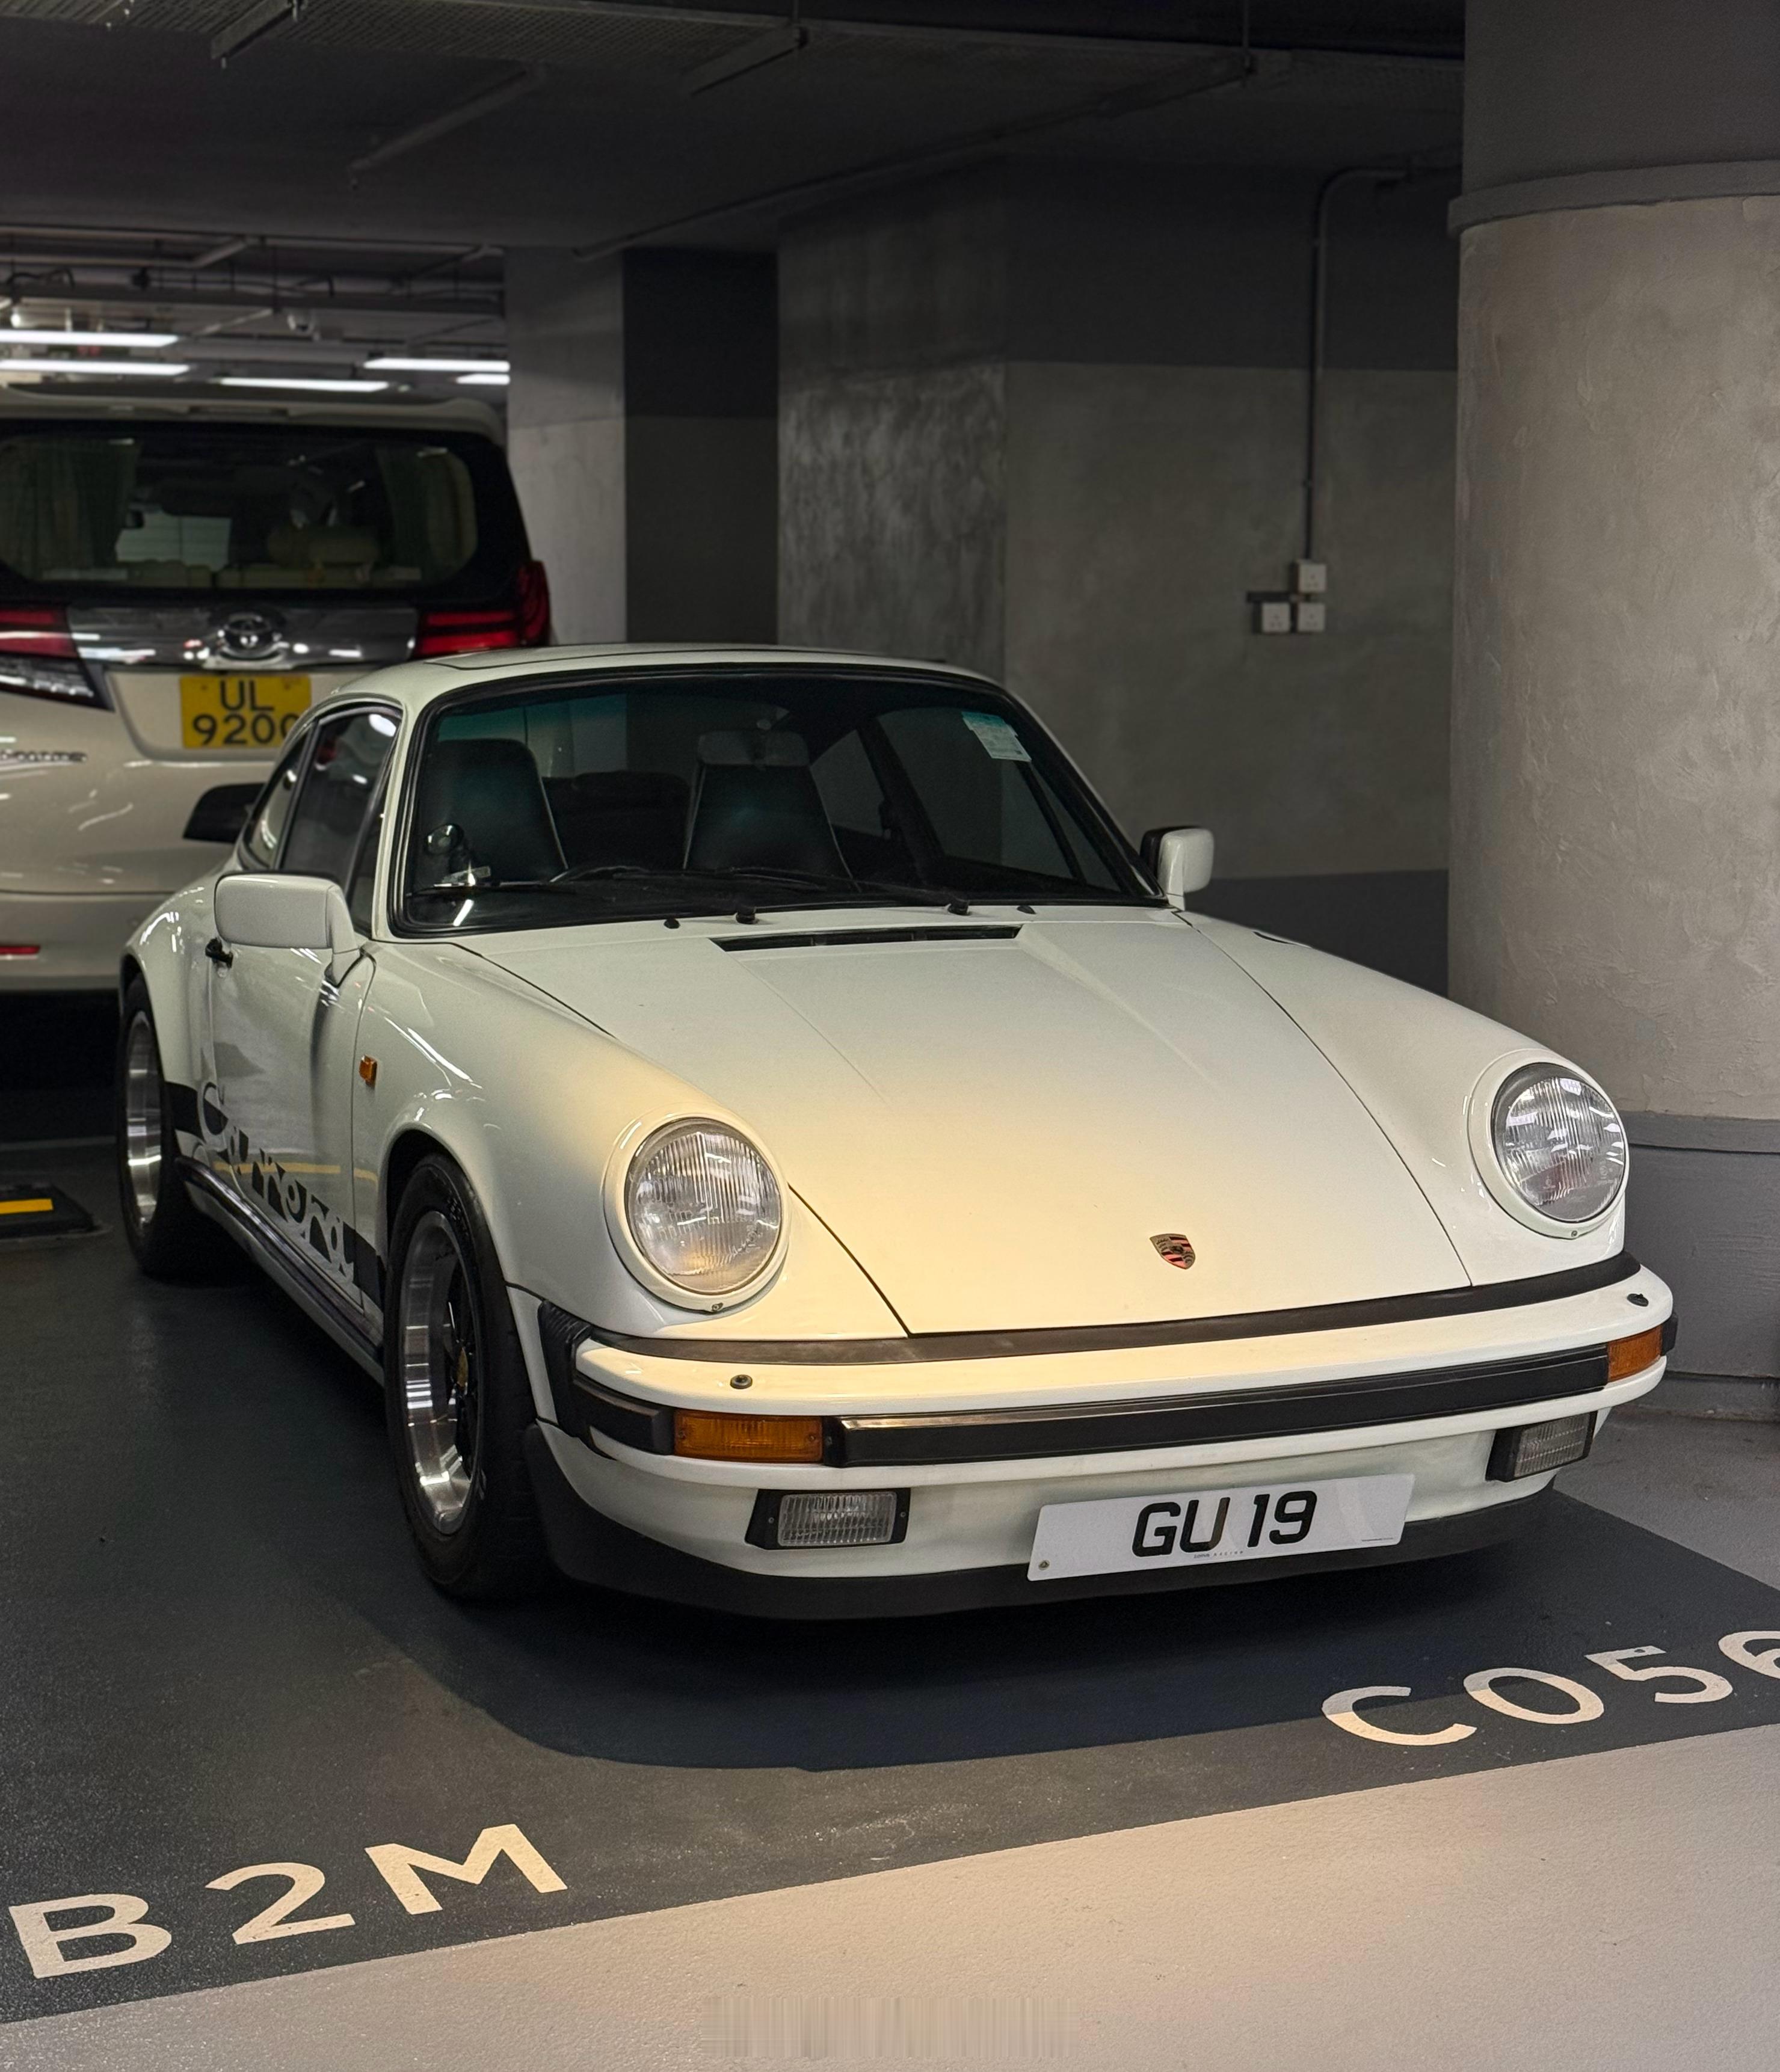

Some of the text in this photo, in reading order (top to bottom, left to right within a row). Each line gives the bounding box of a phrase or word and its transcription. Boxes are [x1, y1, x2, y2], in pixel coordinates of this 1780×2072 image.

[220, 680, 275, 712] UL
[1132, 1490, 1317, 1557] GU 19
[8, 1824, 568, 1979] B2M
